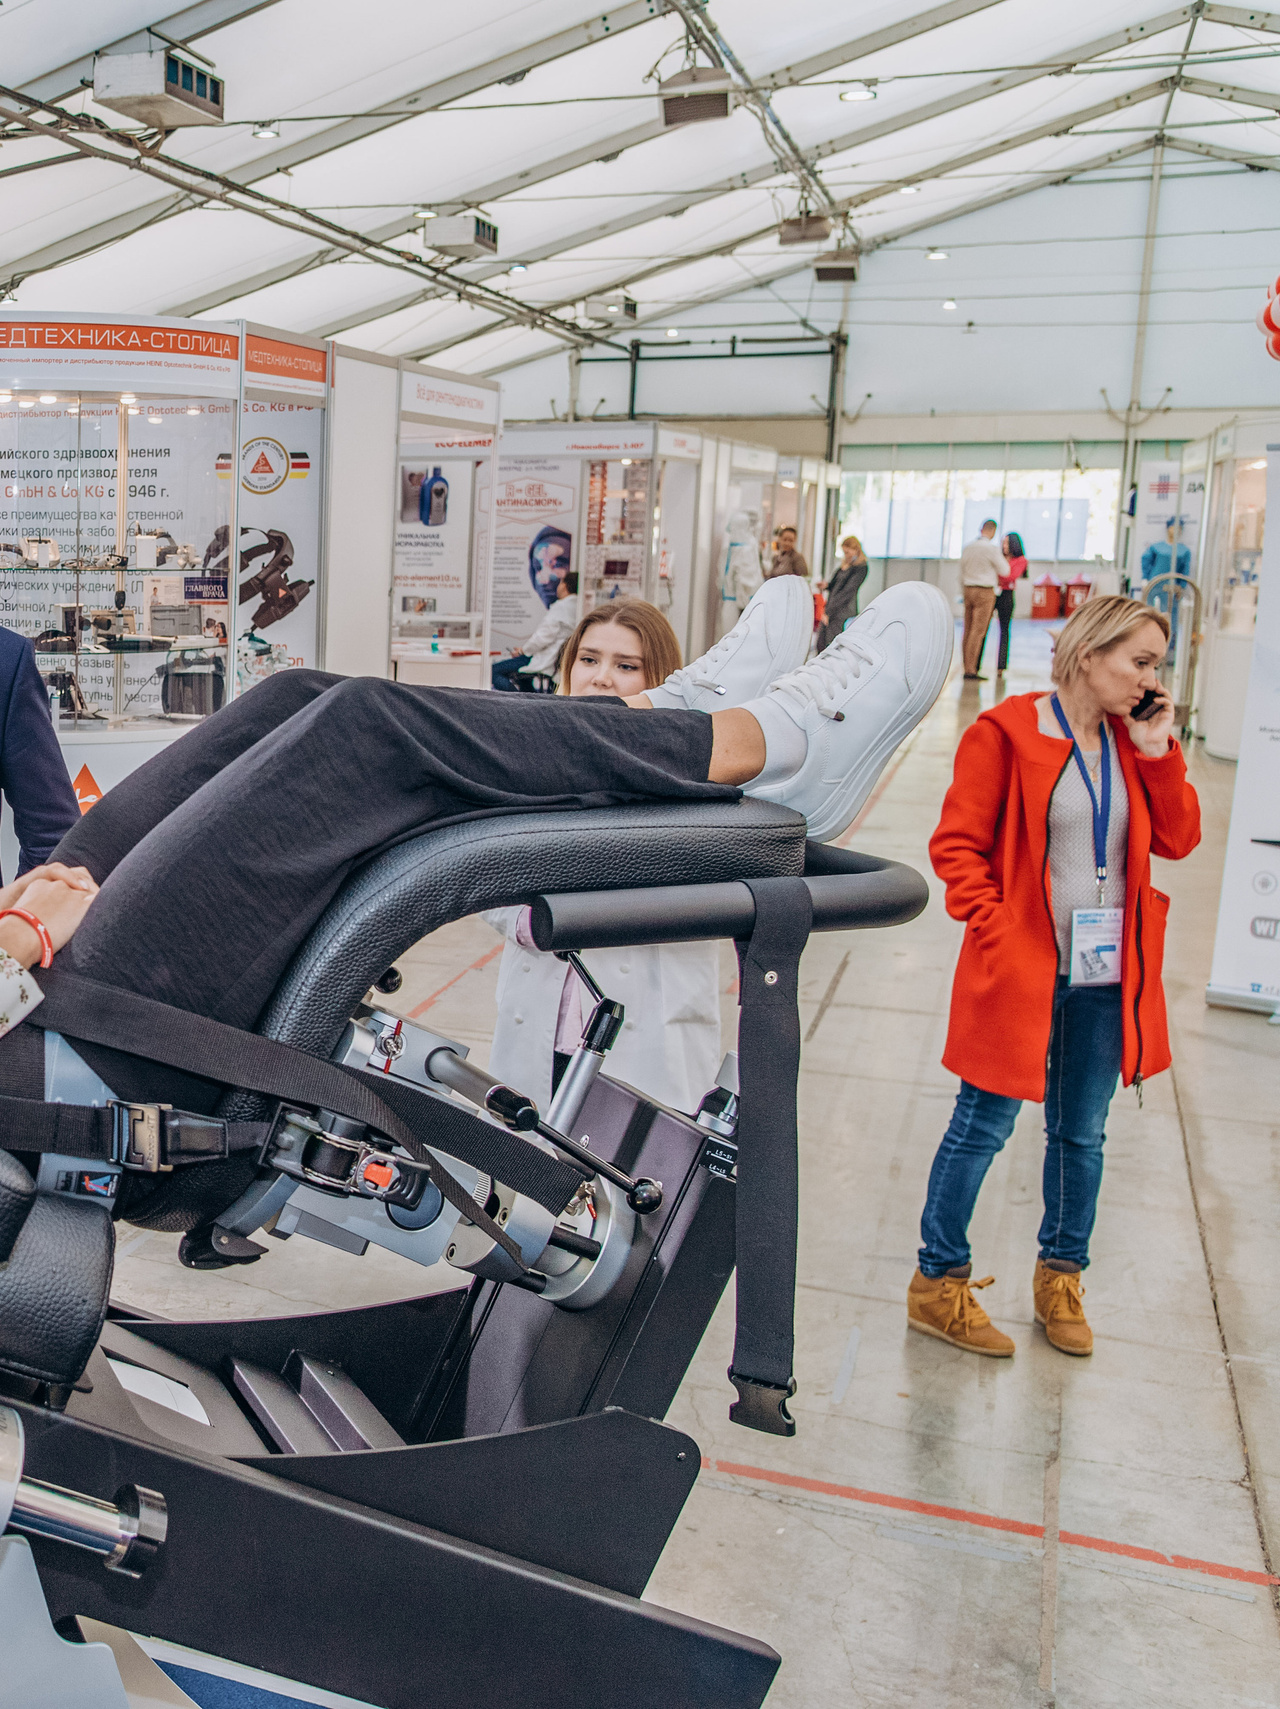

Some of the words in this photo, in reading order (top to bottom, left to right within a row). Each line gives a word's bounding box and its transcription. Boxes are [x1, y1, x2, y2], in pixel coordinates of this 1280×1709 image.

[70, 358, 114, 366] дистрибьютор
[115, 360, 146, 368] продукции
[146, 360, 163, 368] HEINE
[164, 362, 192, 370] Optotechnik
[248, 350, 323, 373] МЕДТЕХНИКА-СТОЛИЦА
[208, 404, 230, 414] Gmb
[270, 402, 286, 412] KG
[53, 448, 170, 462] здравоохнения
[57, 468, 158, 481] производтеля
[48, 486, 57, 498] &
[84, 486, 104, 498] KG
[128, 484, 156, 498] 946
[160, 488, 170, 498] г.
[11, 510, 97, 523] преимущества
[100, 510, 184, 520] каственной
[52, 582, 128, 594] учреждених
[70, 658, 130, 669] оказываь
[90, 676, 104, 684] на
